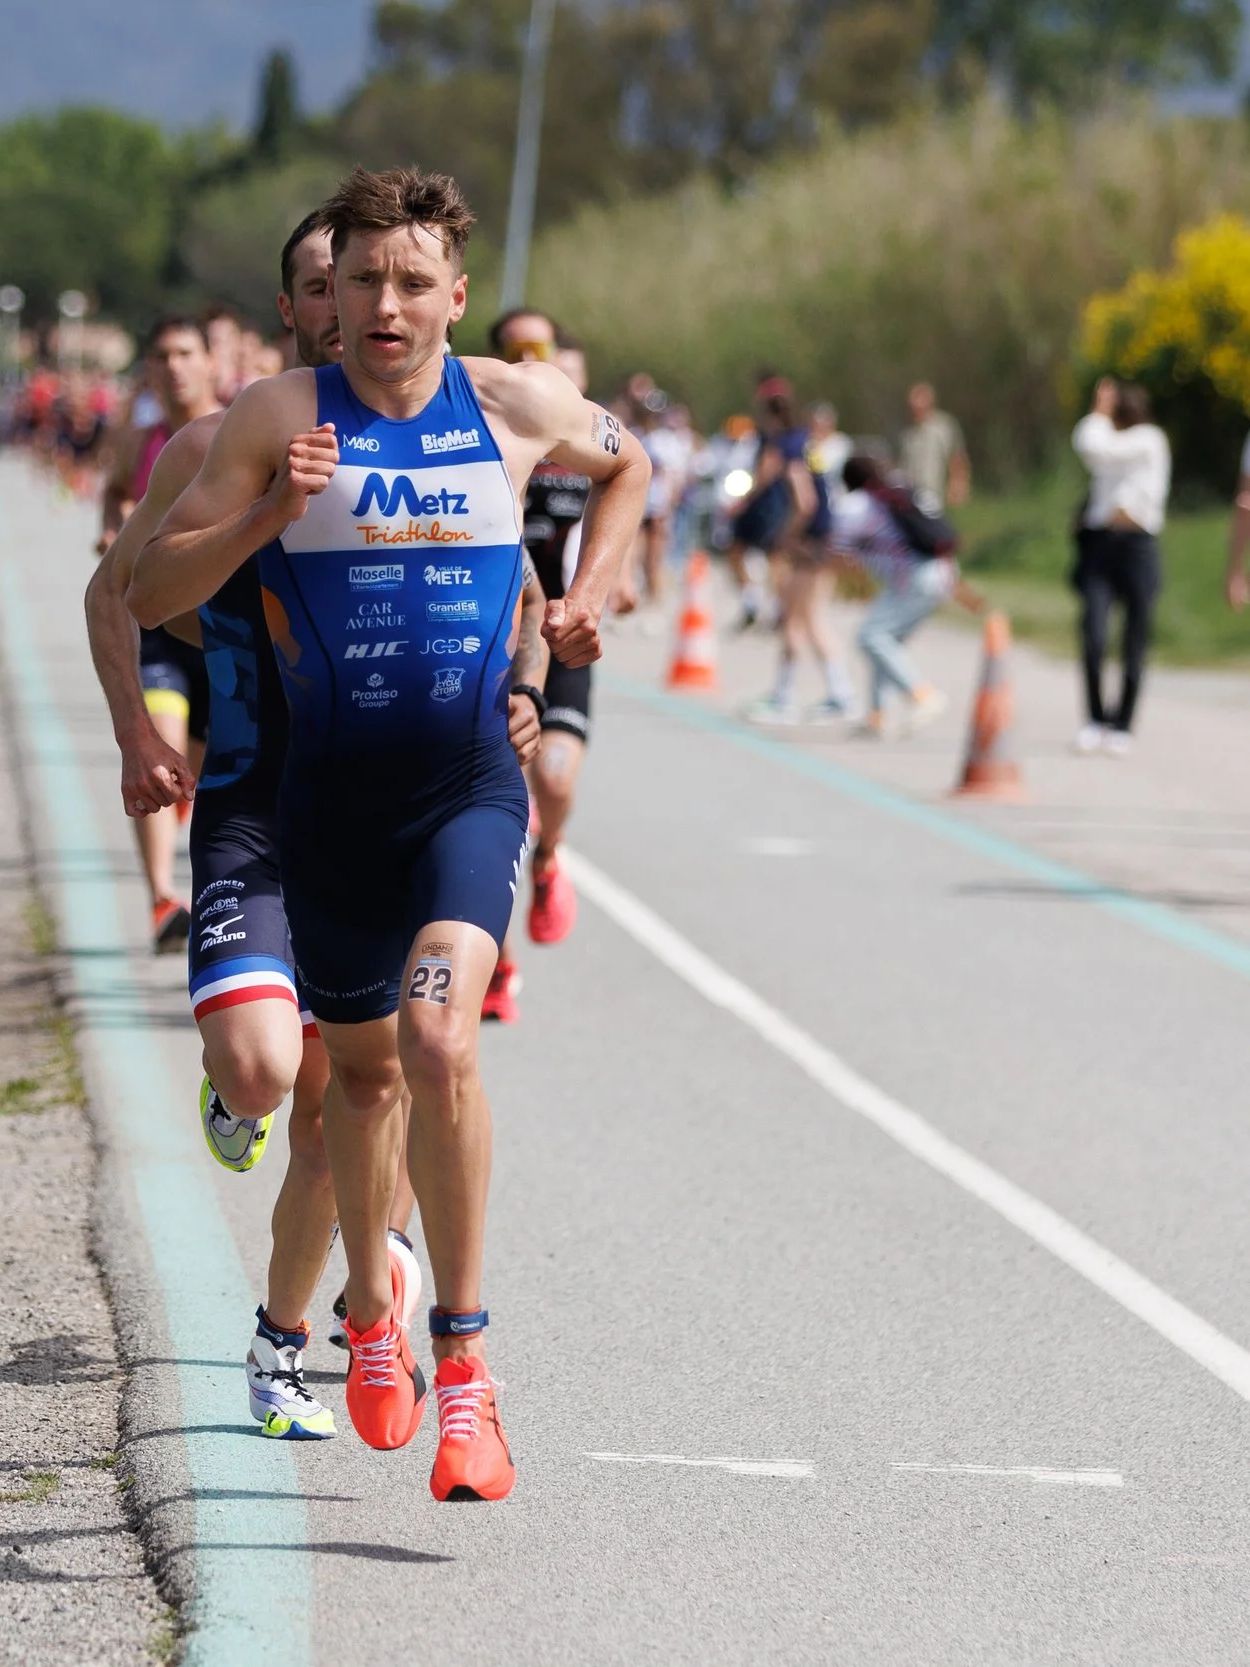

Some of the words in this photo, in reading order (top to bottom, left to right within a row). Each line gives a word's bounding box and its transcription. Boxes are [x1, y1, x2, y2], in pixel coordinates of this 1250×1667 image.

[342, 433, 381, 453] MAKO
[421, 428, 480, 453] BigMat
[602, 415, 623, 457] 22
[350, 472, 470, 518] Metz
[356, 519, 475, 545] Triathlon
[350, 566, 402, 581] Moselle
[427, 570, 472, 585] METZ
[358, 602, 393, 617] CAR
[345, 614, 406, 631] AVENUE
[344, 640, 410, 660] HJC
[433, 685, 461, 697] STORY
[436, 678, 461, 689] CYCLO
[352, 688, 399, 702] Proxiso
[358, 700, 391, 709] Groupe
[407, 966, 453, 1005] 22
